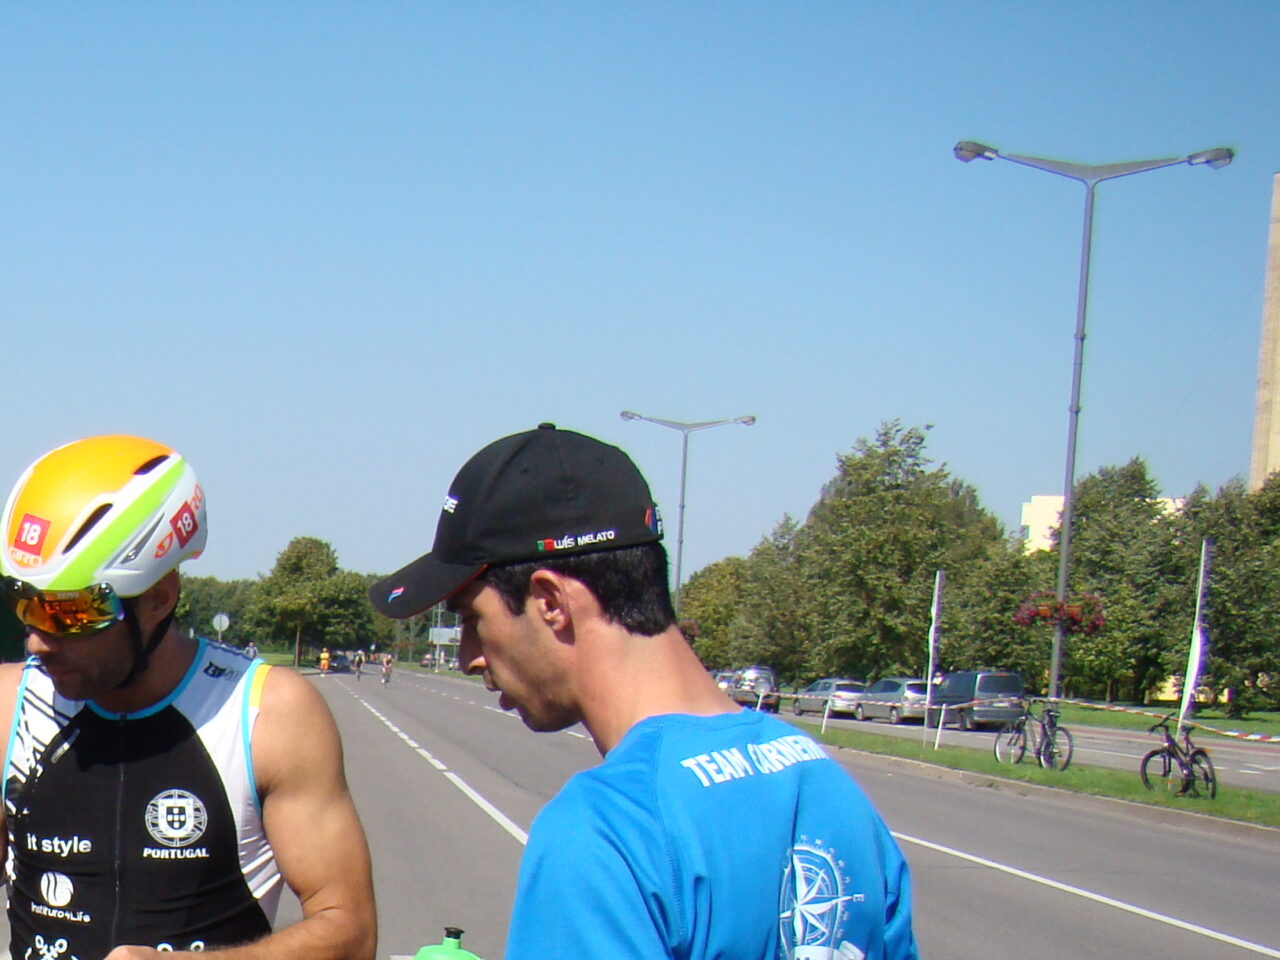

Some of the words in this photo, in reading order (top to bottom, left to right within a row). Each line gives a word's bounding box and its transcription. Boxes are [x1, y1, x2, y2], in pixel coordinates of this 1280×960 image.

[21, 521, 41, 545] 18
[177, 512, 193, 537] 18
[577, 530, 615, 546] MELATO
[680, 747, 754, 787] TEAM
[42, 836, 92, 857] style
[143, 848, 210, 859] PORTUGAL
